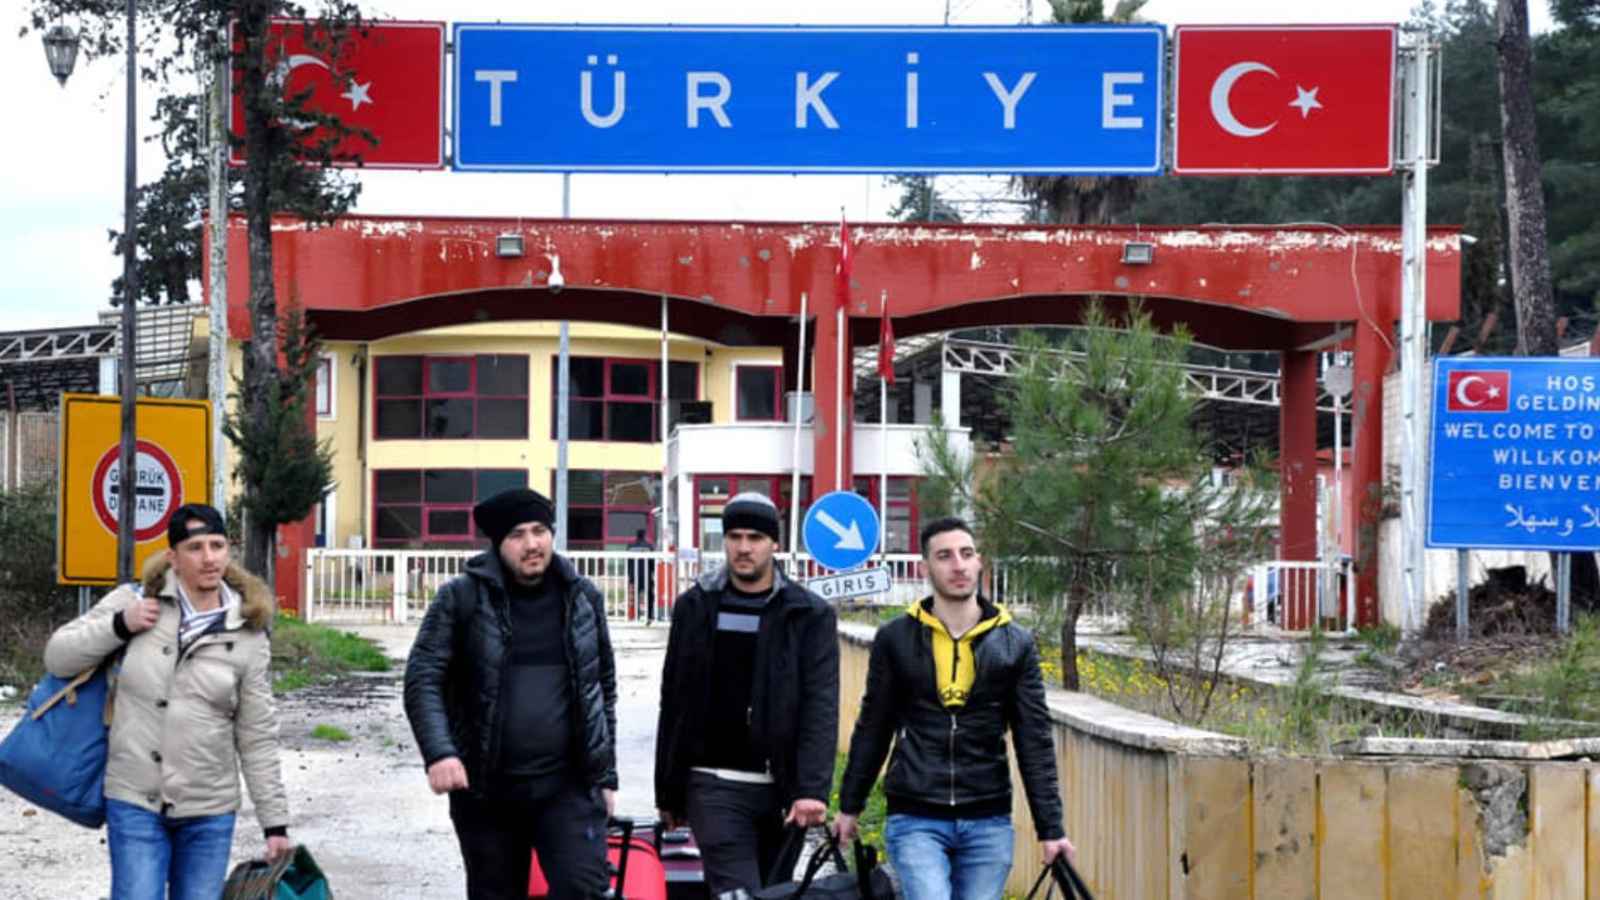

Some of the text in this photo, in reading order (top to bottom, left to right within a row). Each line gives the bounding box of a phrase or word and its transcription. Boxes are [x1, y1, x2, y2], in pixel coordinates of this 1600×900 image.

[475, 53, 1144, 129] TÜRKİYE
[1444, 423, 1594, 440] WELCOME TO
[110, 467, 164, 484] GRÜK
[109, 496, 164, 512] DANE
